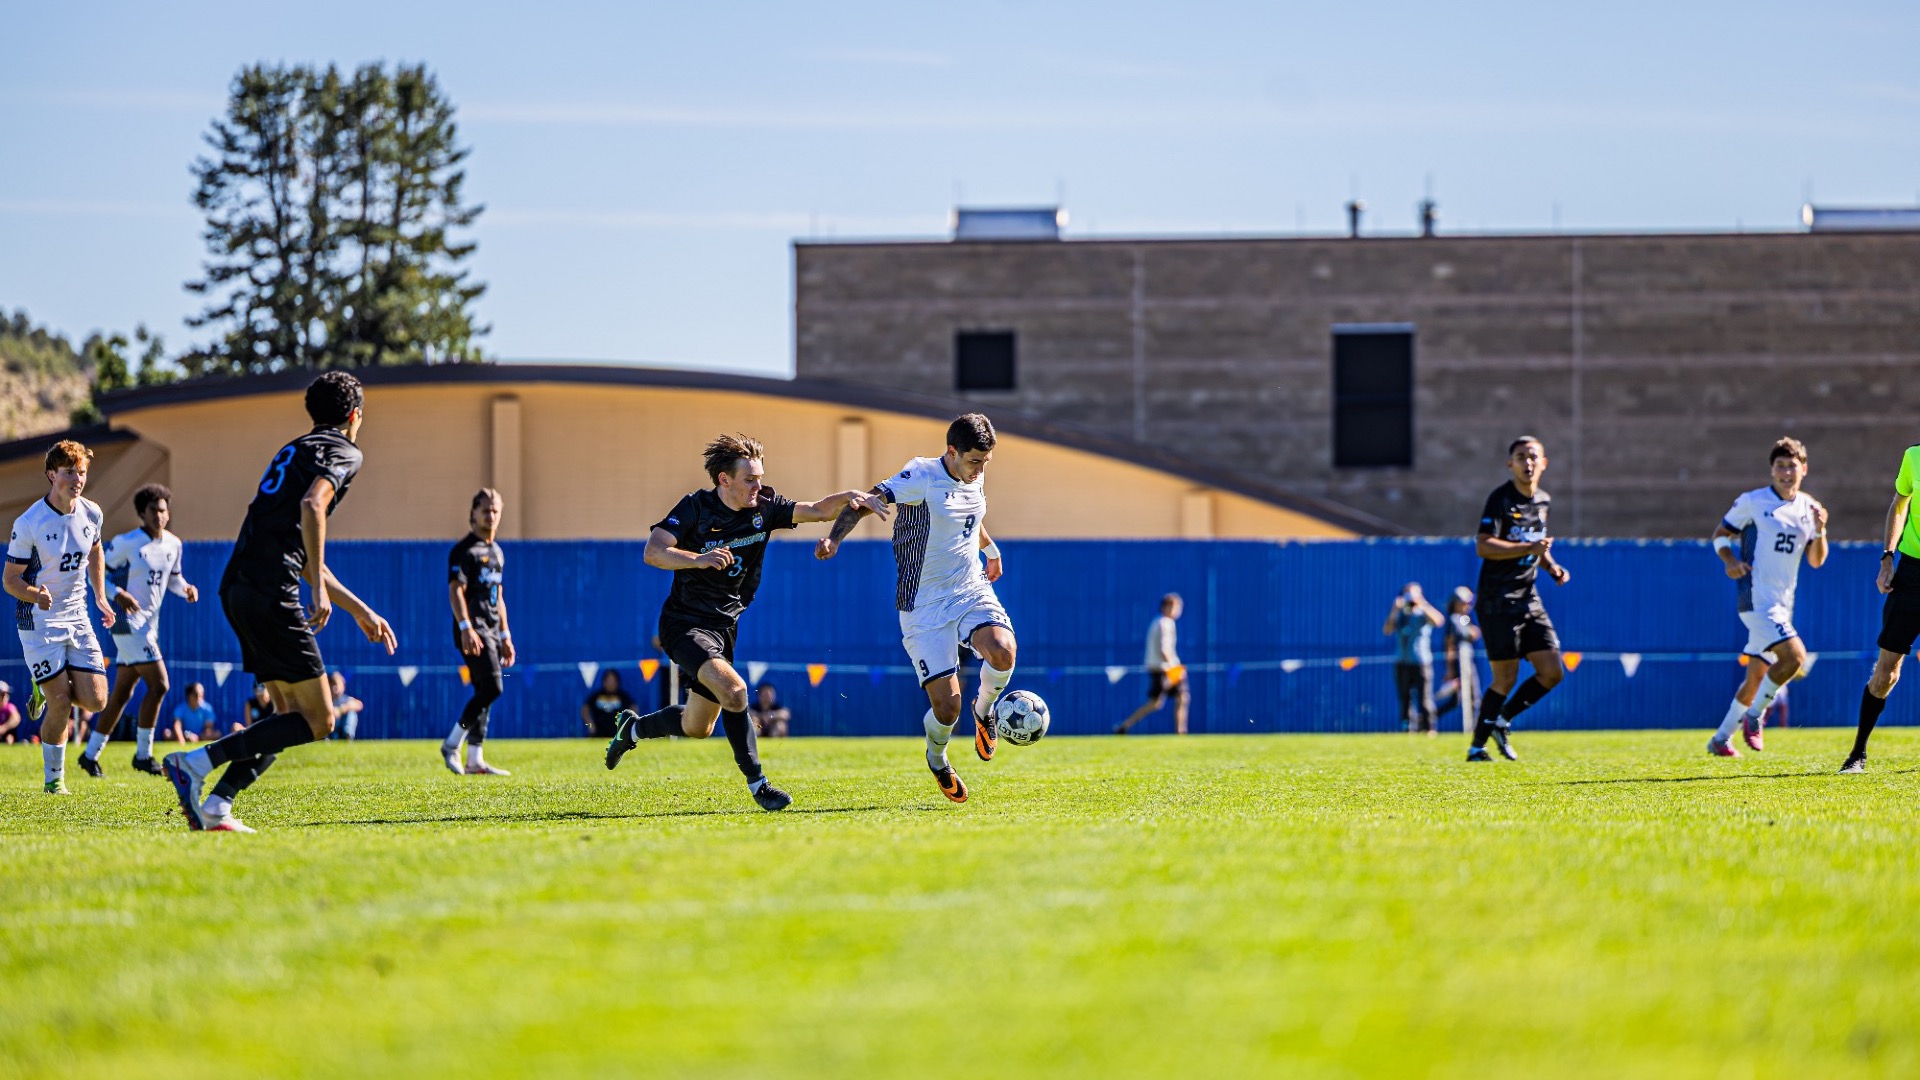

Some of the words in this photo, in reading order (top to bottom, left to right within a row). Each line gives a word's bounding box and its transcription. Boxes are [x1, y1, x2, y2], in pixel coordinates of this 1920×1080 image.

[260, 445, 296, 494] 3
[962, 514, 976, 538] 9
[1774, 532, 1796, 554] 25
[60, 552, 83, 572] 23
[147, 570, 163, 586] 32
[32, 659, 52, 679] 23
[919, 659, 930, 677] 9
[999, 723, 1028, 741] SELECT
